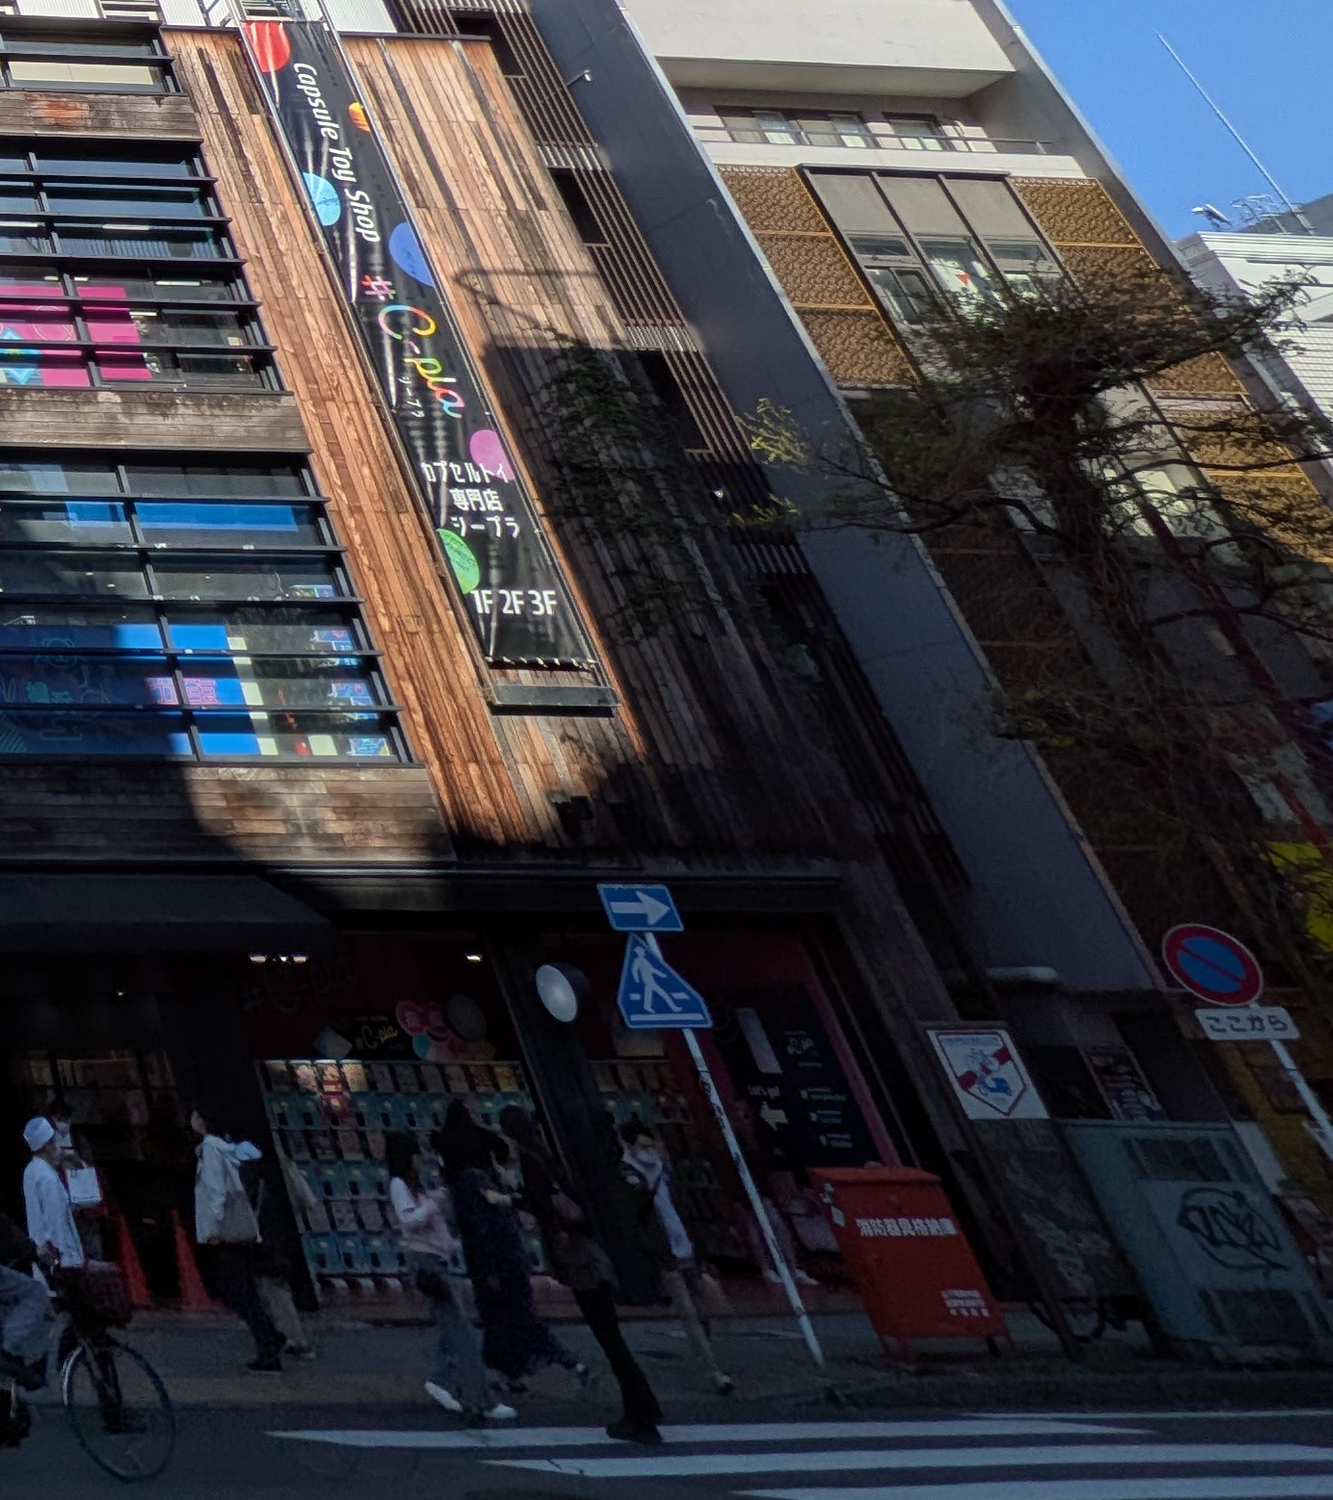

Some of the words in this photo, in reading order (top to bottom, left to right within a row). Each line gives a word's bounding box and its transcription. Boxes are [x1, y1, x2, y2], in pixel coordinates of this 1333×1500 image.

[293, 61, 339, 140] Capsule
[329, 146, 358, 183] Toy
[345, 189, 381, 244] Shop
[420, 460, 509, 484] カプセルトイ
[448, 487, 504, 512] 専門店
[450, 515, 521, 539] シープラ
[469, 589, 494, 614] 1F
[498, 589, 525, 615] 2F
[528, 589, 558, 616] 3F
[1206, 1015, 1289, 1034] ここから
